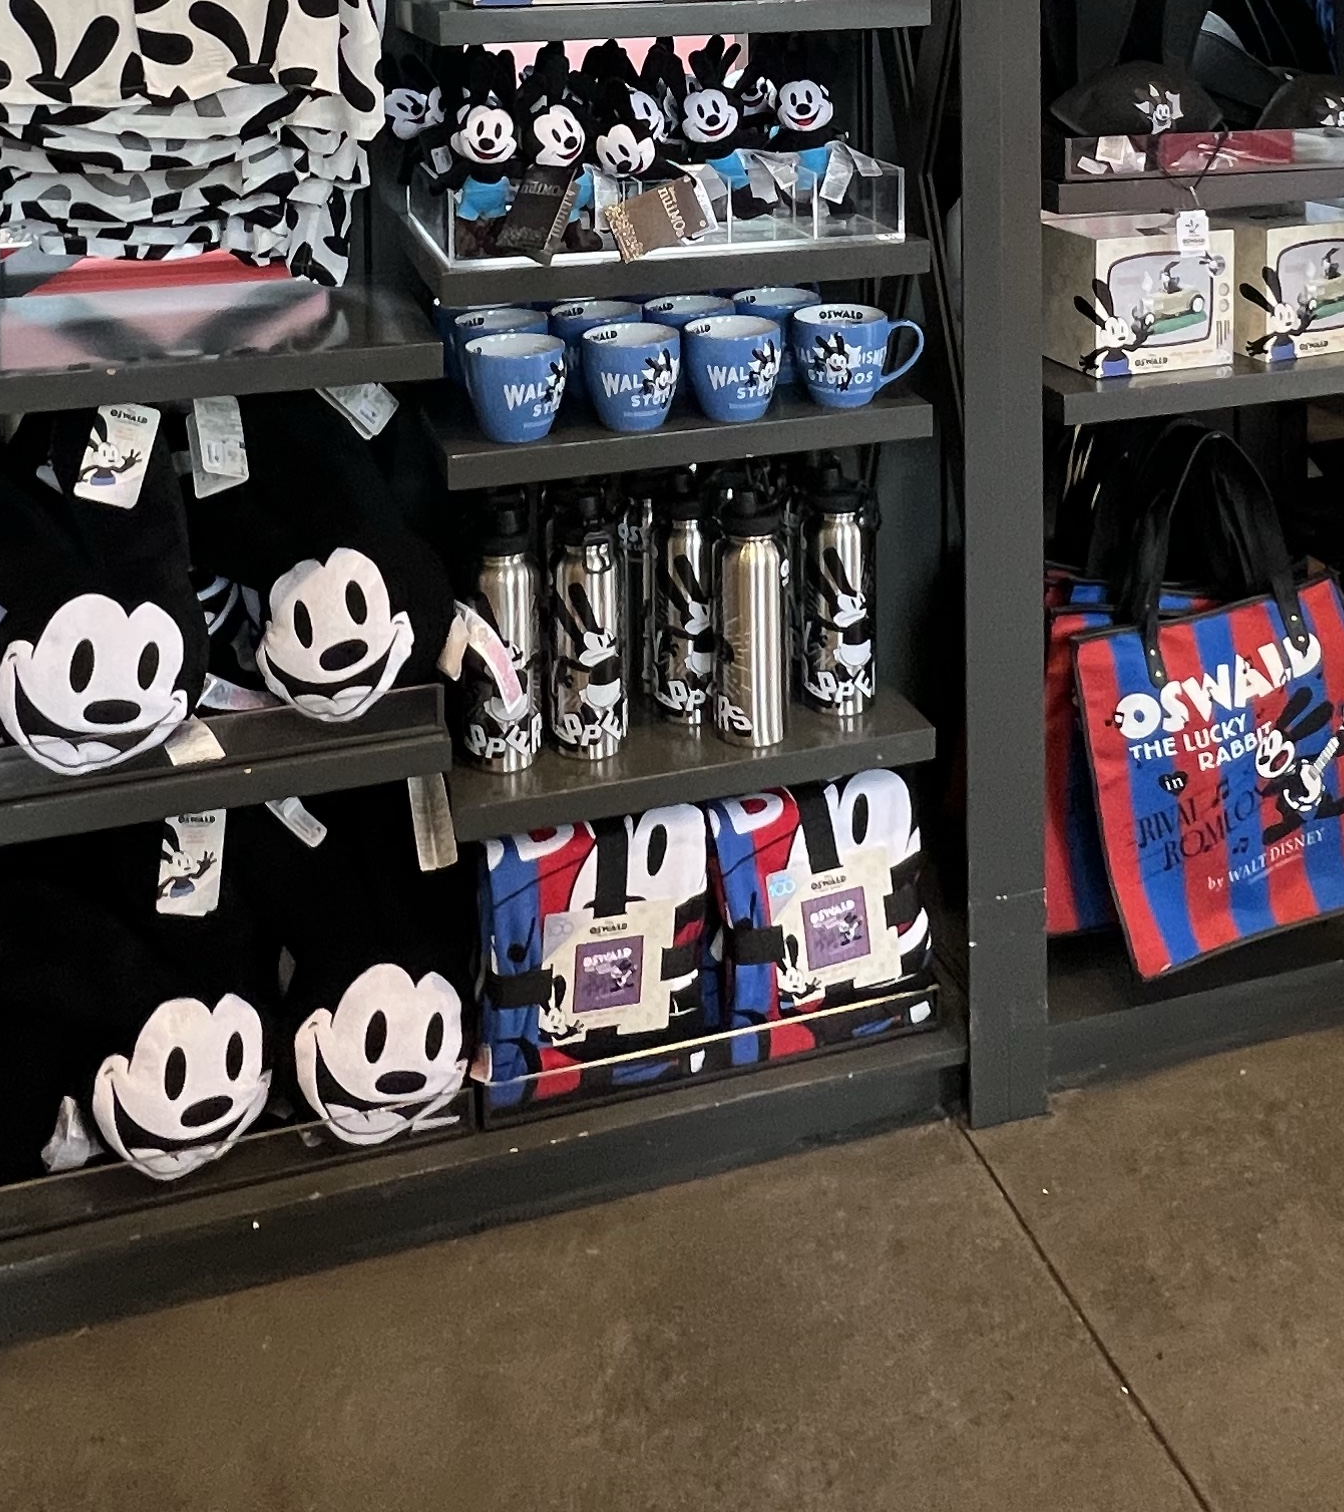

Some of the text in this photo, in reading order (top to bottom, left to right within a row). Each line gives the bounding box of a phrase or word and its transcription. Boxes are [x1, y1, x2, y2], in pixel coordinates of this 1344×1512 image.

[818, 308, 864, 320] OSWALD
[591, 330, 618, 341] WALD
[600, 371, 644, 398] WAL
[706, 363, 751, 391] WAL
[502, 381, 547, 412] WAL
[109, 408, 148, 424] OSWALD
[1114, 632, 1323, 740] OSWALD
[1129, 713, 1246, 763] THE LUCKY
[1198, 720, 1274, 772] RABBIT
[1164, 772, 1184, 791] in
[1137, 797, 1198, 849] RIVAL
[1207, 827, 1326, 891] by WALT DISNEY
[810, 874, 847, 891] OSWALD
[809, 899, 856, 925] OSWALD
[589, 922, 628, 935] OSWALD
[582, 947, 633, 968] OSWALD
